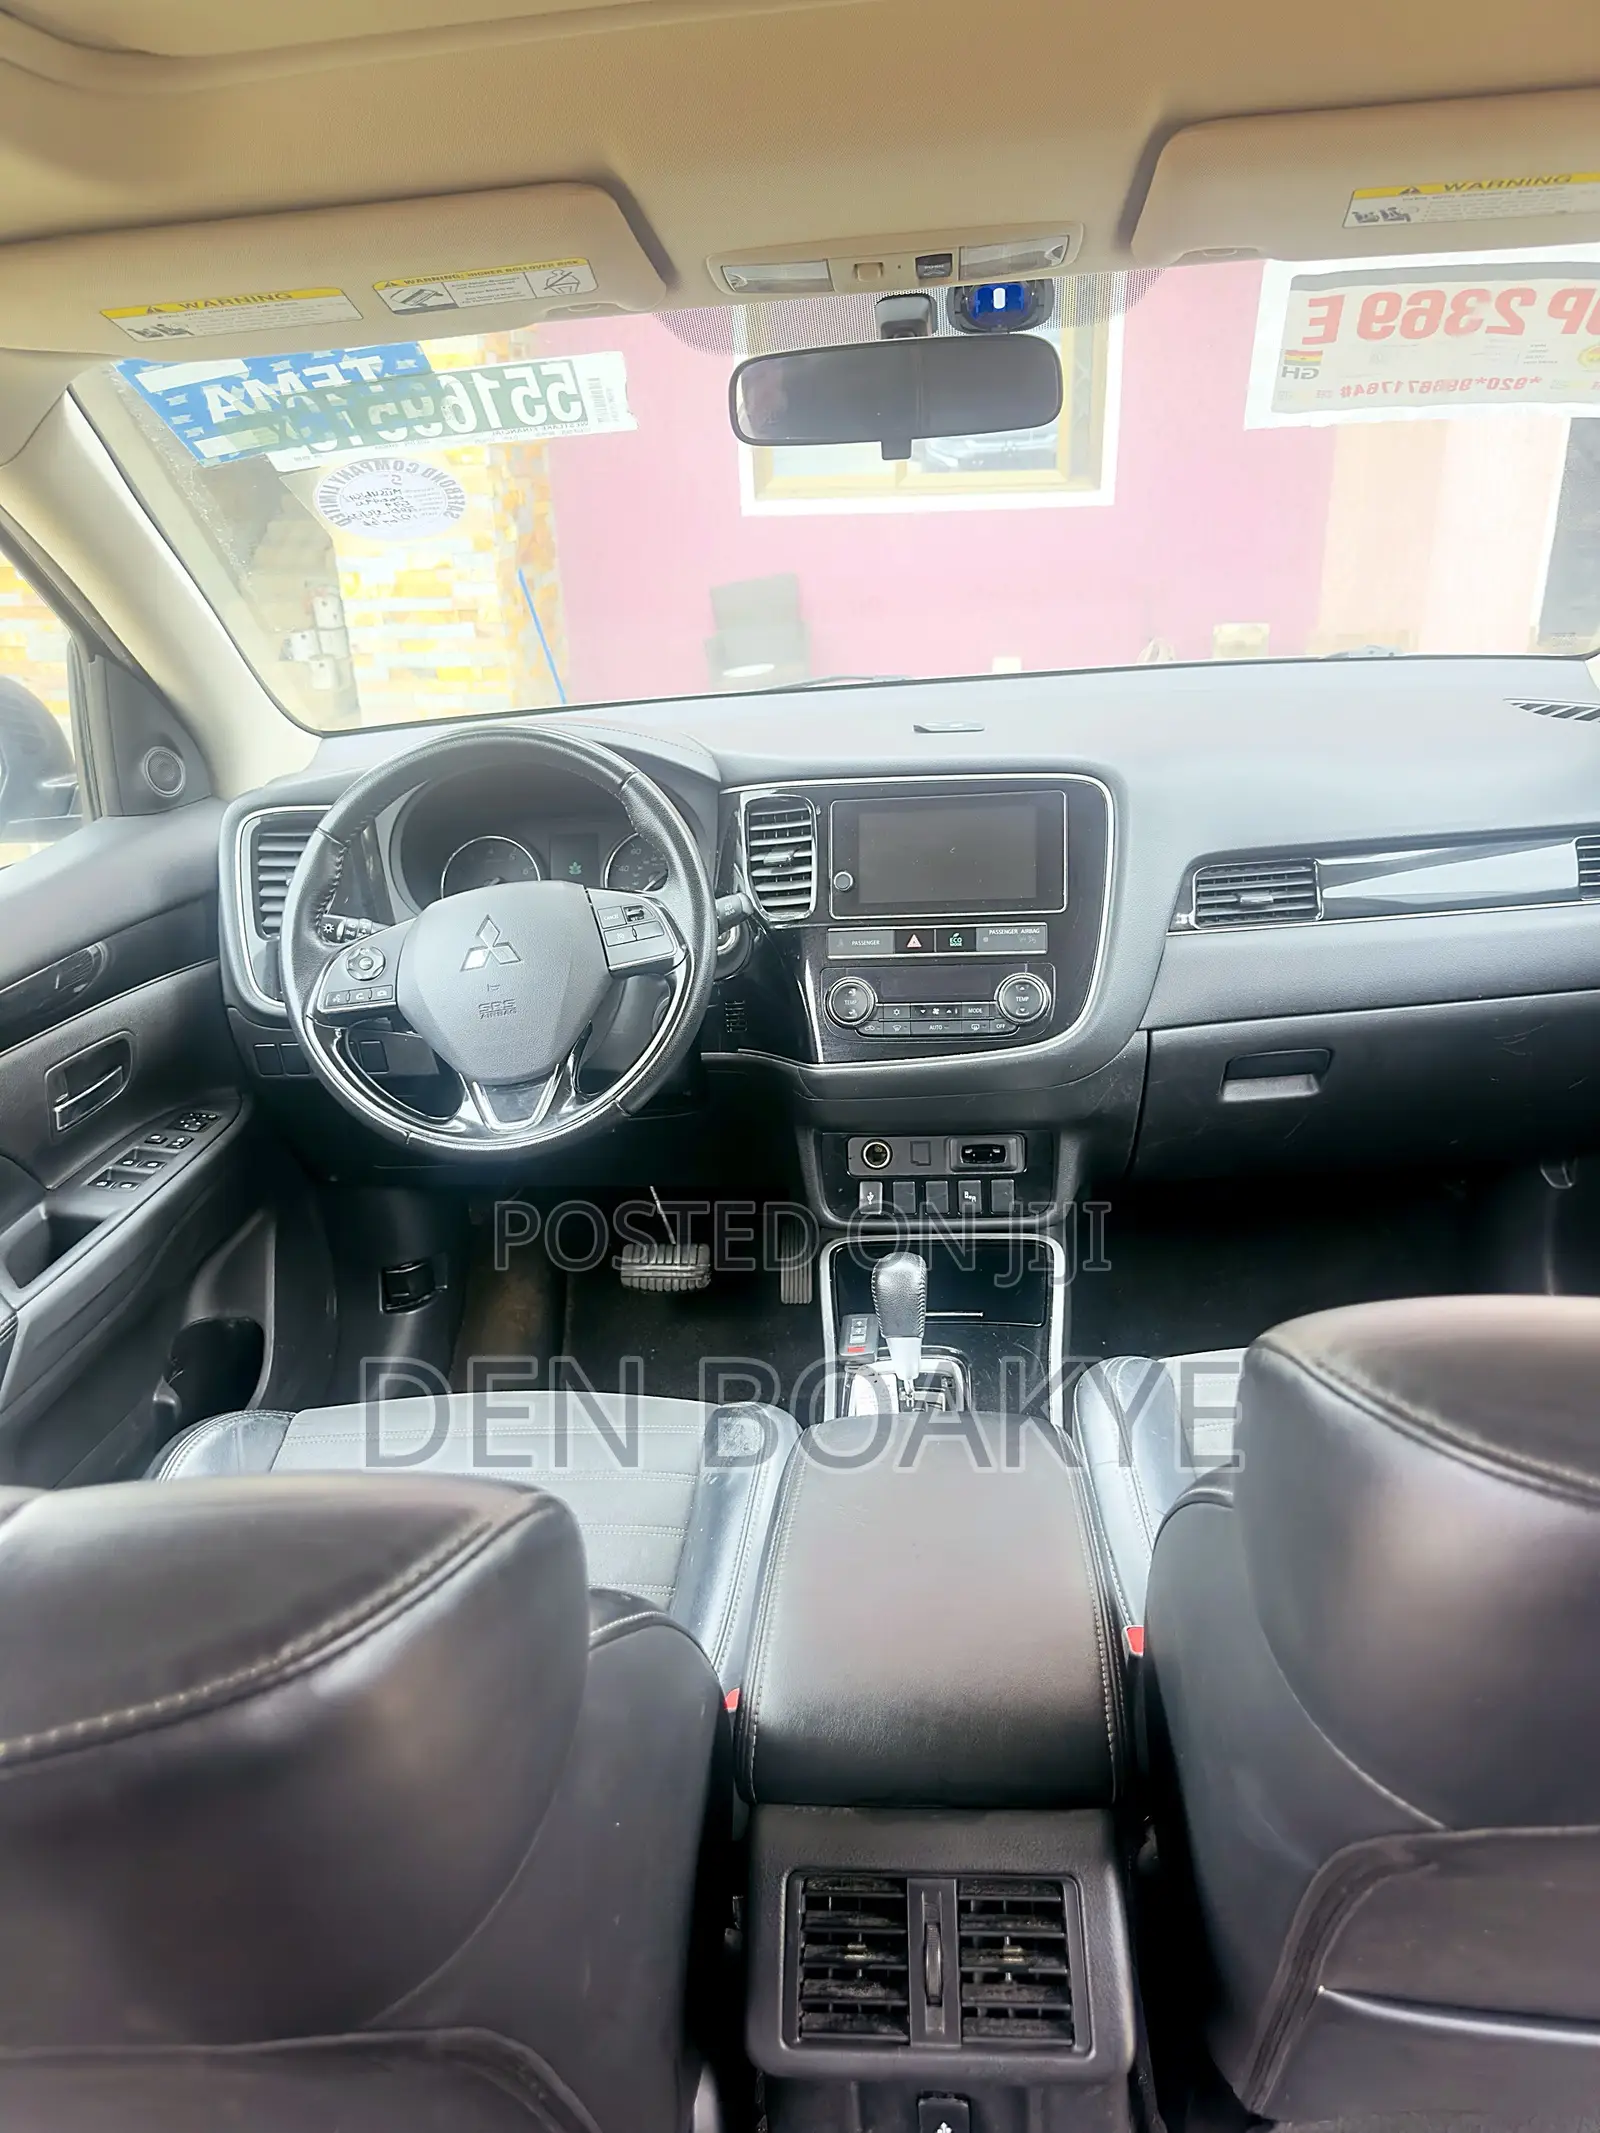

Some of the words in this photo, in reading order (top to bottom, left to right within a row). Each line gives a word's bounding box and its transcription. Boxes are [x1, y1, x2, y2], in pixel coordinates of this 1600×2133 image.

[1443, 174, 1572, 192] WARNING
[403, 273, 465, 286] WARNING:
[505, 262, 555, 273] ROLLOVER
[179, 291, 293, 311] WARNING
[988, 928, 1019, 936] PASSENGER
